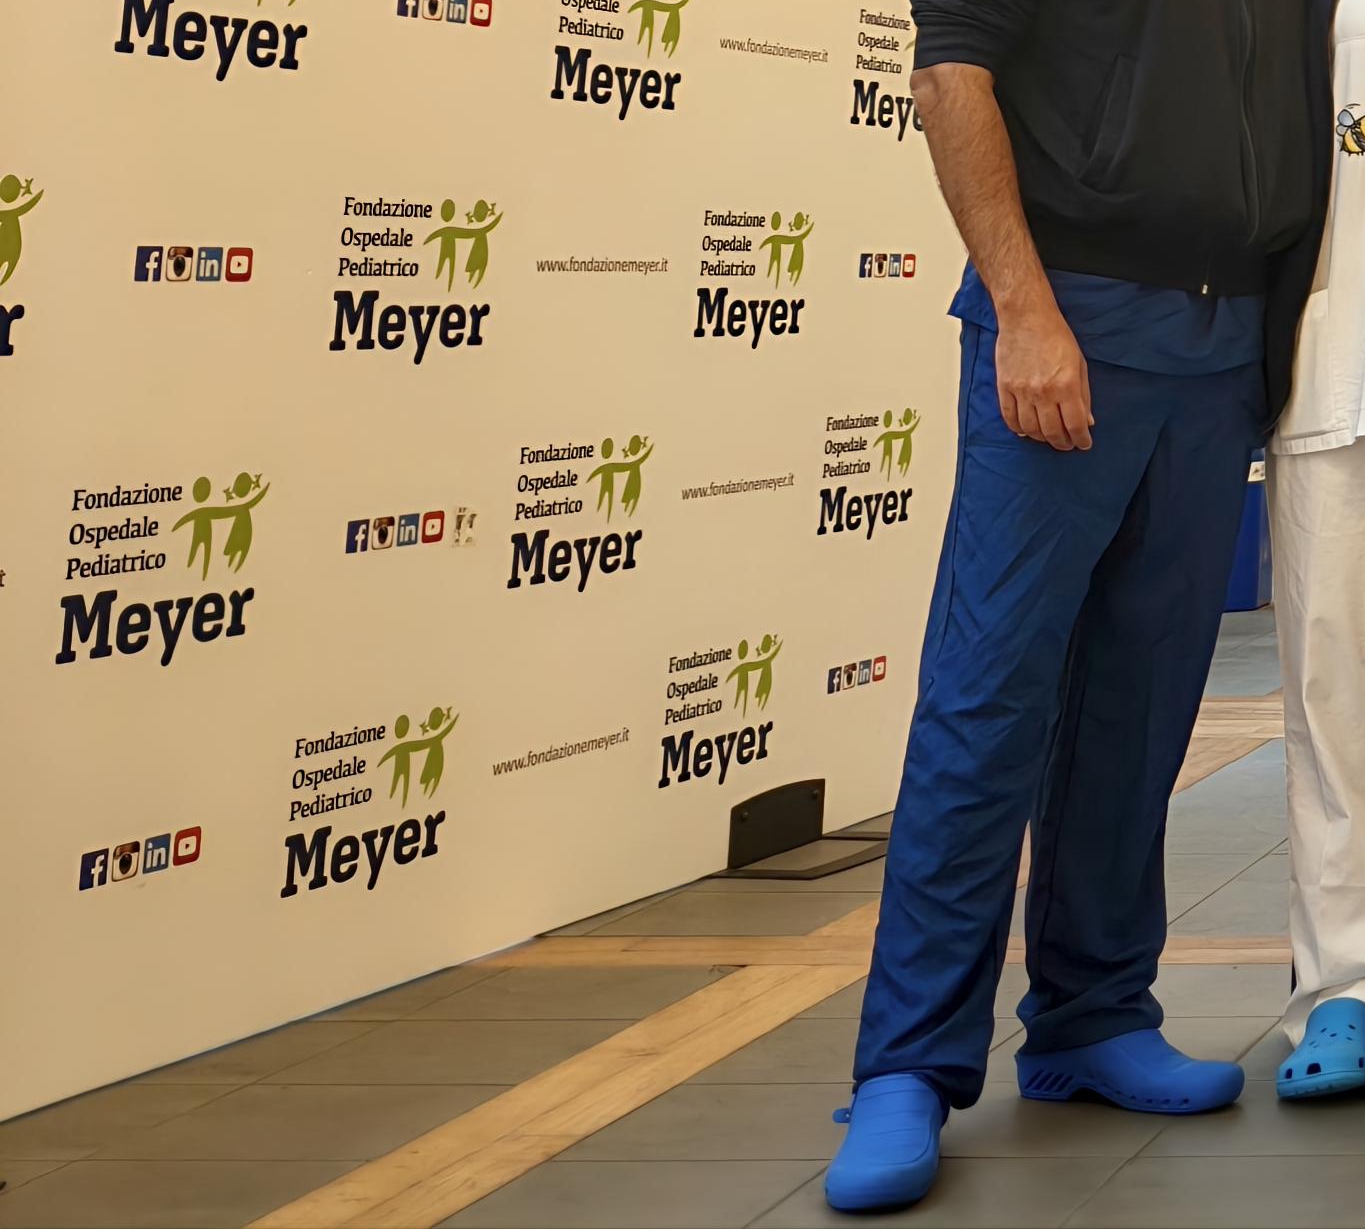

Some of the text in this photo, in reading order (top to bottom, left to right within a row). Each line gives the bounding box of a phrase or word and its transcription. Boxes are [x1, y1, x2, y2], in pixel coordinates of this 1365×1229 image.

[558, 16, 624, 40] Pediatrico
[859, 9, 910, 30] Fondazione
[719, 36, 828, 63] www.fondazionemeyer.it
[858, 32, 899, 52] Ospedale
[856, 54, 902, 74] Pediatrico
[550, 45, 681, 121] Meyer
[850, 79, 923, 142] Mey
[343, 196, 433, 219] Fondazione
[704, 210, 766, 228] Fondazione
[340, 227, 414, 251] Ospedale
[702, 235, 752, 255] Ospedale
[338, 257, 419, 278] Pediatrico
[536, 256, 668, 276] www.fondazionemeyer.it
[700, 260, 756, 277] Pediatrico
[329, 290, 490, 365] Meyer
[694, 287, 805, 350] Meyer
[826, 414, 879, 431] Fondazione
[519, 442, 594, 464] Fondazione
[824, 437, 868, 456] Ospedale
[517, 470, 578, 494] Ospedale
[822, 460, 871, 478] Pediatrico
[72, 483, 183, 511] Fondazione
[681, 472, 795, 500] www.fondazionemeyer.it
[515, 498, 583, 521] Pediatrico
[817, 485, 913, 541] Meyer
[69, 516, 159, 549] Ospedale
[65, 550, 166, 580] Pediatrico
[507, 529, 642, 593] Meyer
[55, 587, 255, 667] Meyer
[669, 647, 732, 673] Fondazione
[667, 673, 718, 701] Ospedale
[665, 698, 722, 726] Pediatrico
[294, 724, 386, 759] Fondazione
[492, 726, 630, 777] www.fondazionemeyer.it
[658, 721, 773, 789] Meyer
[293, 756, 366, 791] Ospedale
[289, 785, 372, 822] Pediatrico
[280, 810, 446, 899] Meyer
